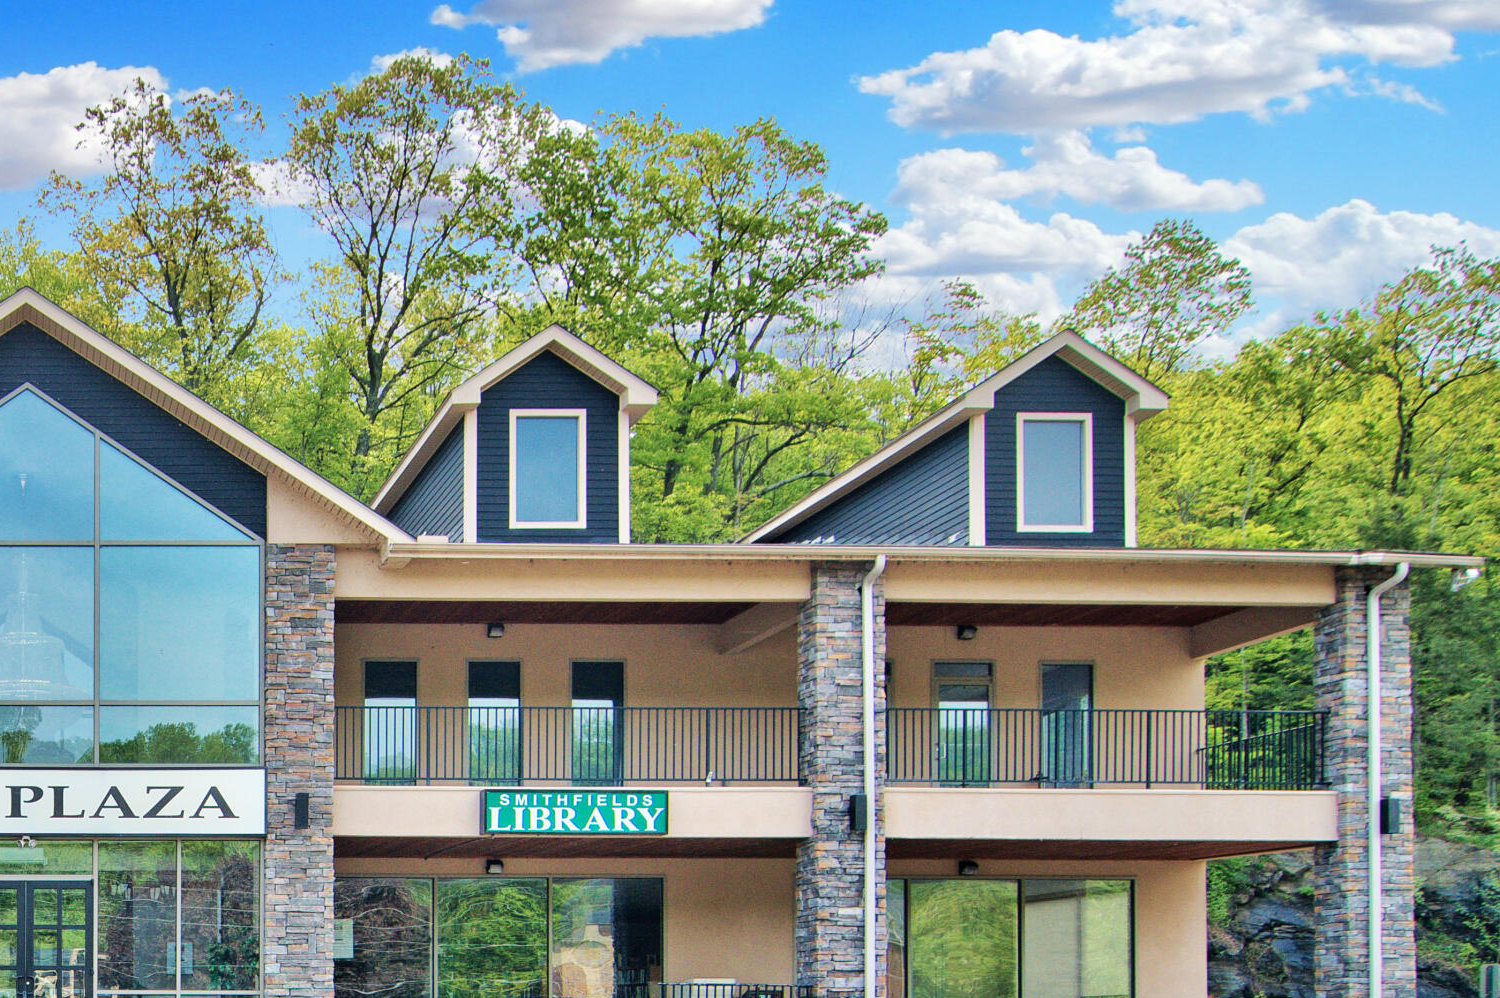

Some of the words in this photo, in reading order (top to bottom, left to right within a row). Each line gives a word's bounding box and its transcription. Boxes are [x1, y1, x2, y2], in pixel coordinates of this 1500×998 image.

[5, 785, 240, 819] PLAZA
[499, 793, 653, 806] SMITHFIELDS
[488, 806, 664, 832] LIBRARY
